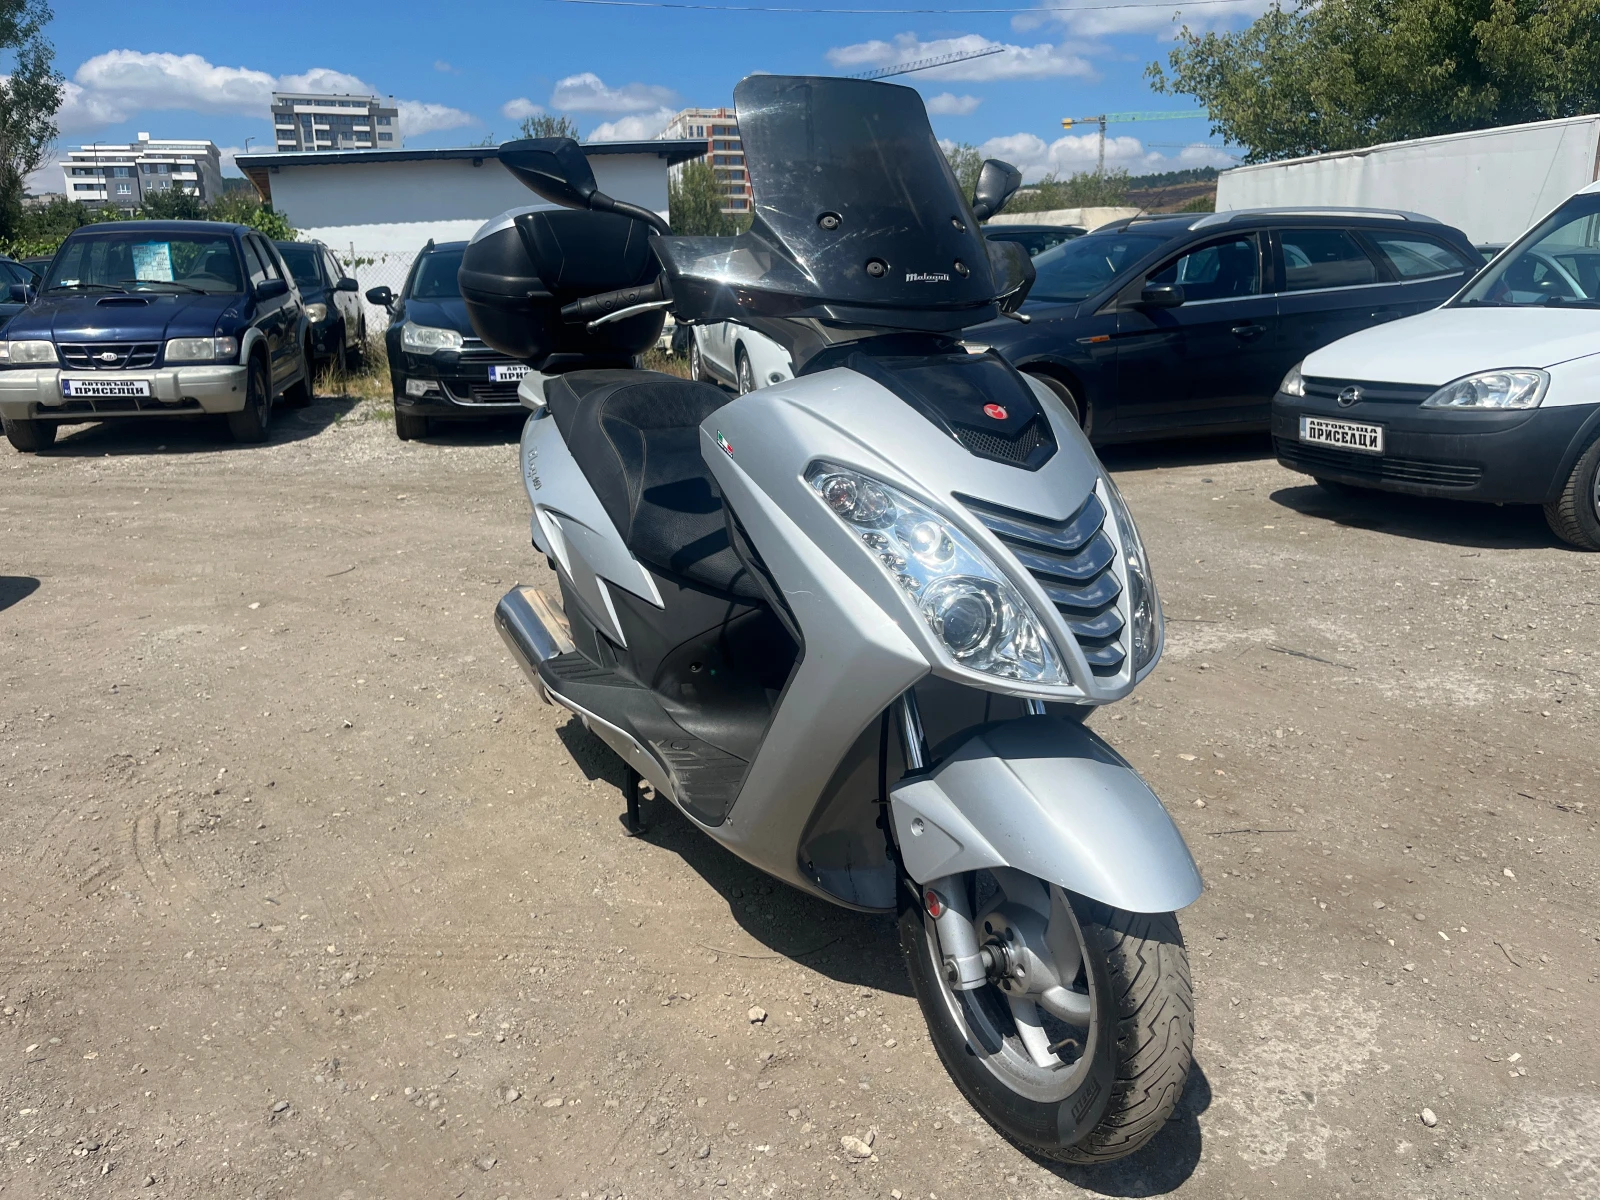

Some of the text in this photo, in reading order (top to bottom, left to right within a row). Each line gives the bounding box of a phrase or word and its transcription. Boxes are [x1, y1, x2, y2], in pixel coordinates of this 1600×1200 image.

[906, 272, 950, 282] Malaguti
[74, 387, 144, 395] ПРИСЕЛЦИ
[1309, 420, 1378, 434] АВТОКЪЩА
[1309, 426, 1378, 449] ПРИСЕЛЦИ
